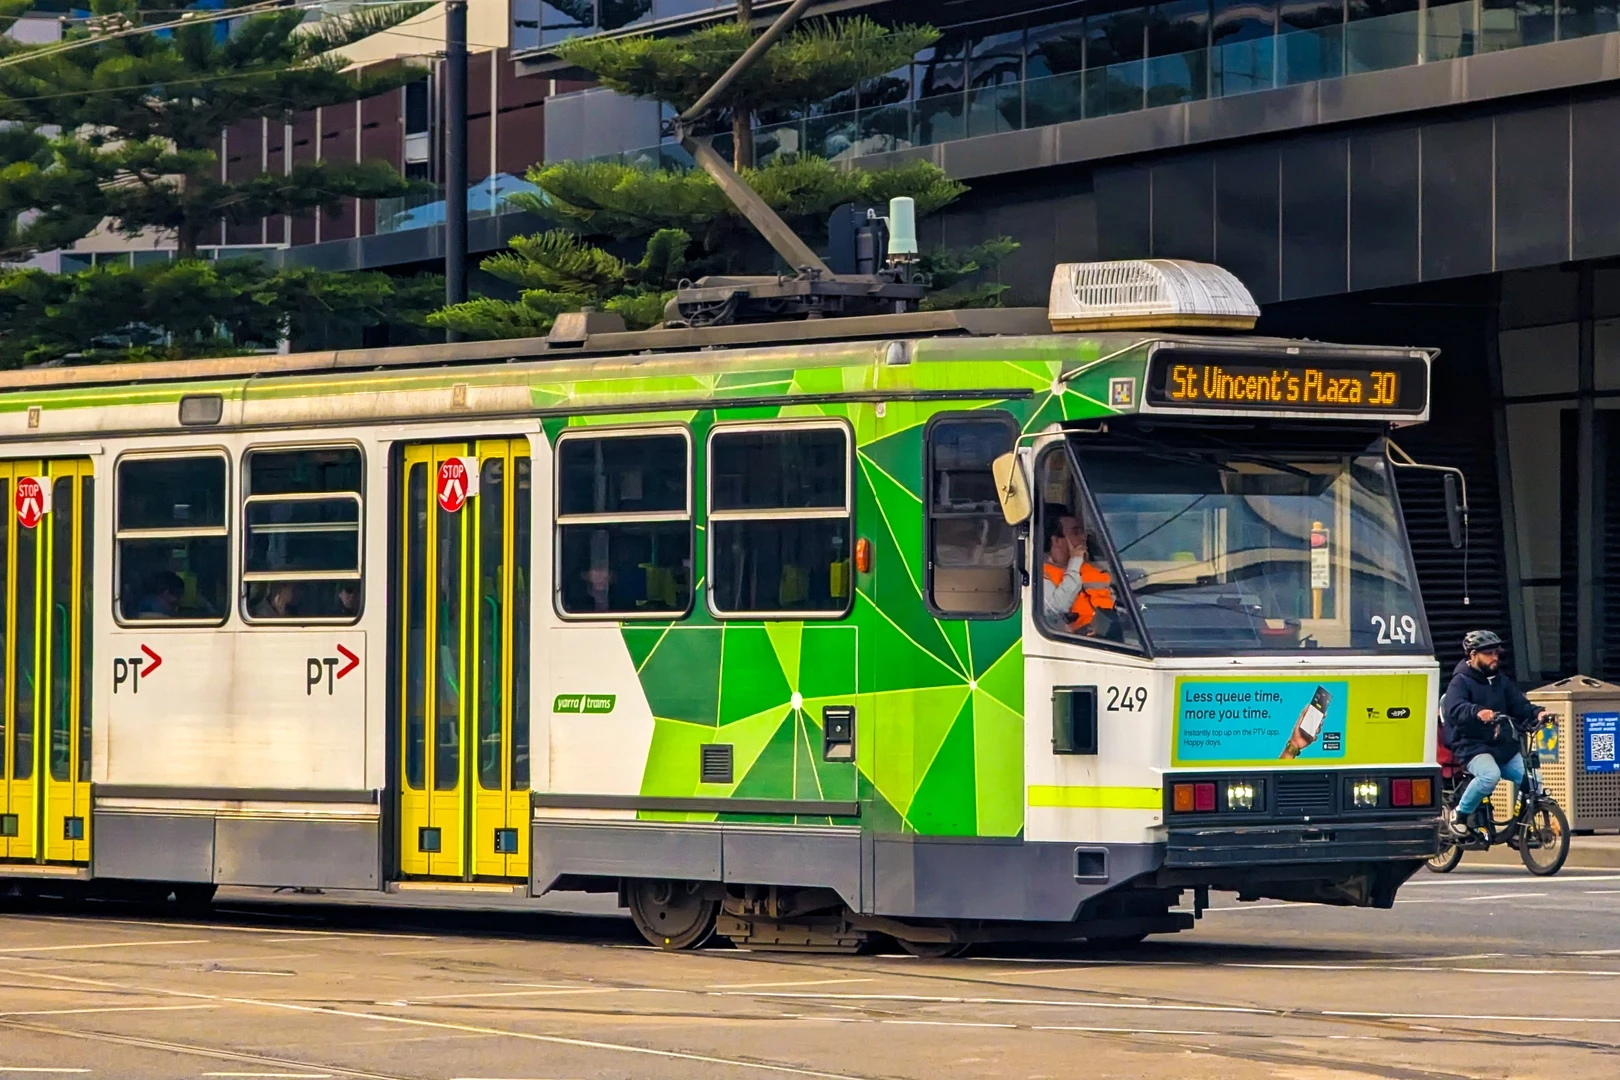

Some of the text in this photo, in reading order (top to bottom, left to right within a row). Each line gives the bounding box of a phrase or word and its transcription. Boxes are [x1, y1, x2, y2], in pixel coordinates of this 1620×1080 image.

[1171, 365, 1397, 404] St Vincent's Plaza 30
[442, 464, 464, 478] STOP
[19, 484, 39, 497] STOP
[1371, 615, 1416, 644] 249
[557, 697, 611, 711] yarra trams
[1106, 685, 1148, 712] 249
[1185, 689, 1283, 705] Less queue time,
[1185, 706, 1271, 722] more you time.
[1184, 728, 1211, 738] Instantly
[1212, 729, 1223, 737] top
[1241, 728, 1252, 736] the
[1252, 728, 1266, 736] PTV
[1183, 739, 1204, 748] Happy
